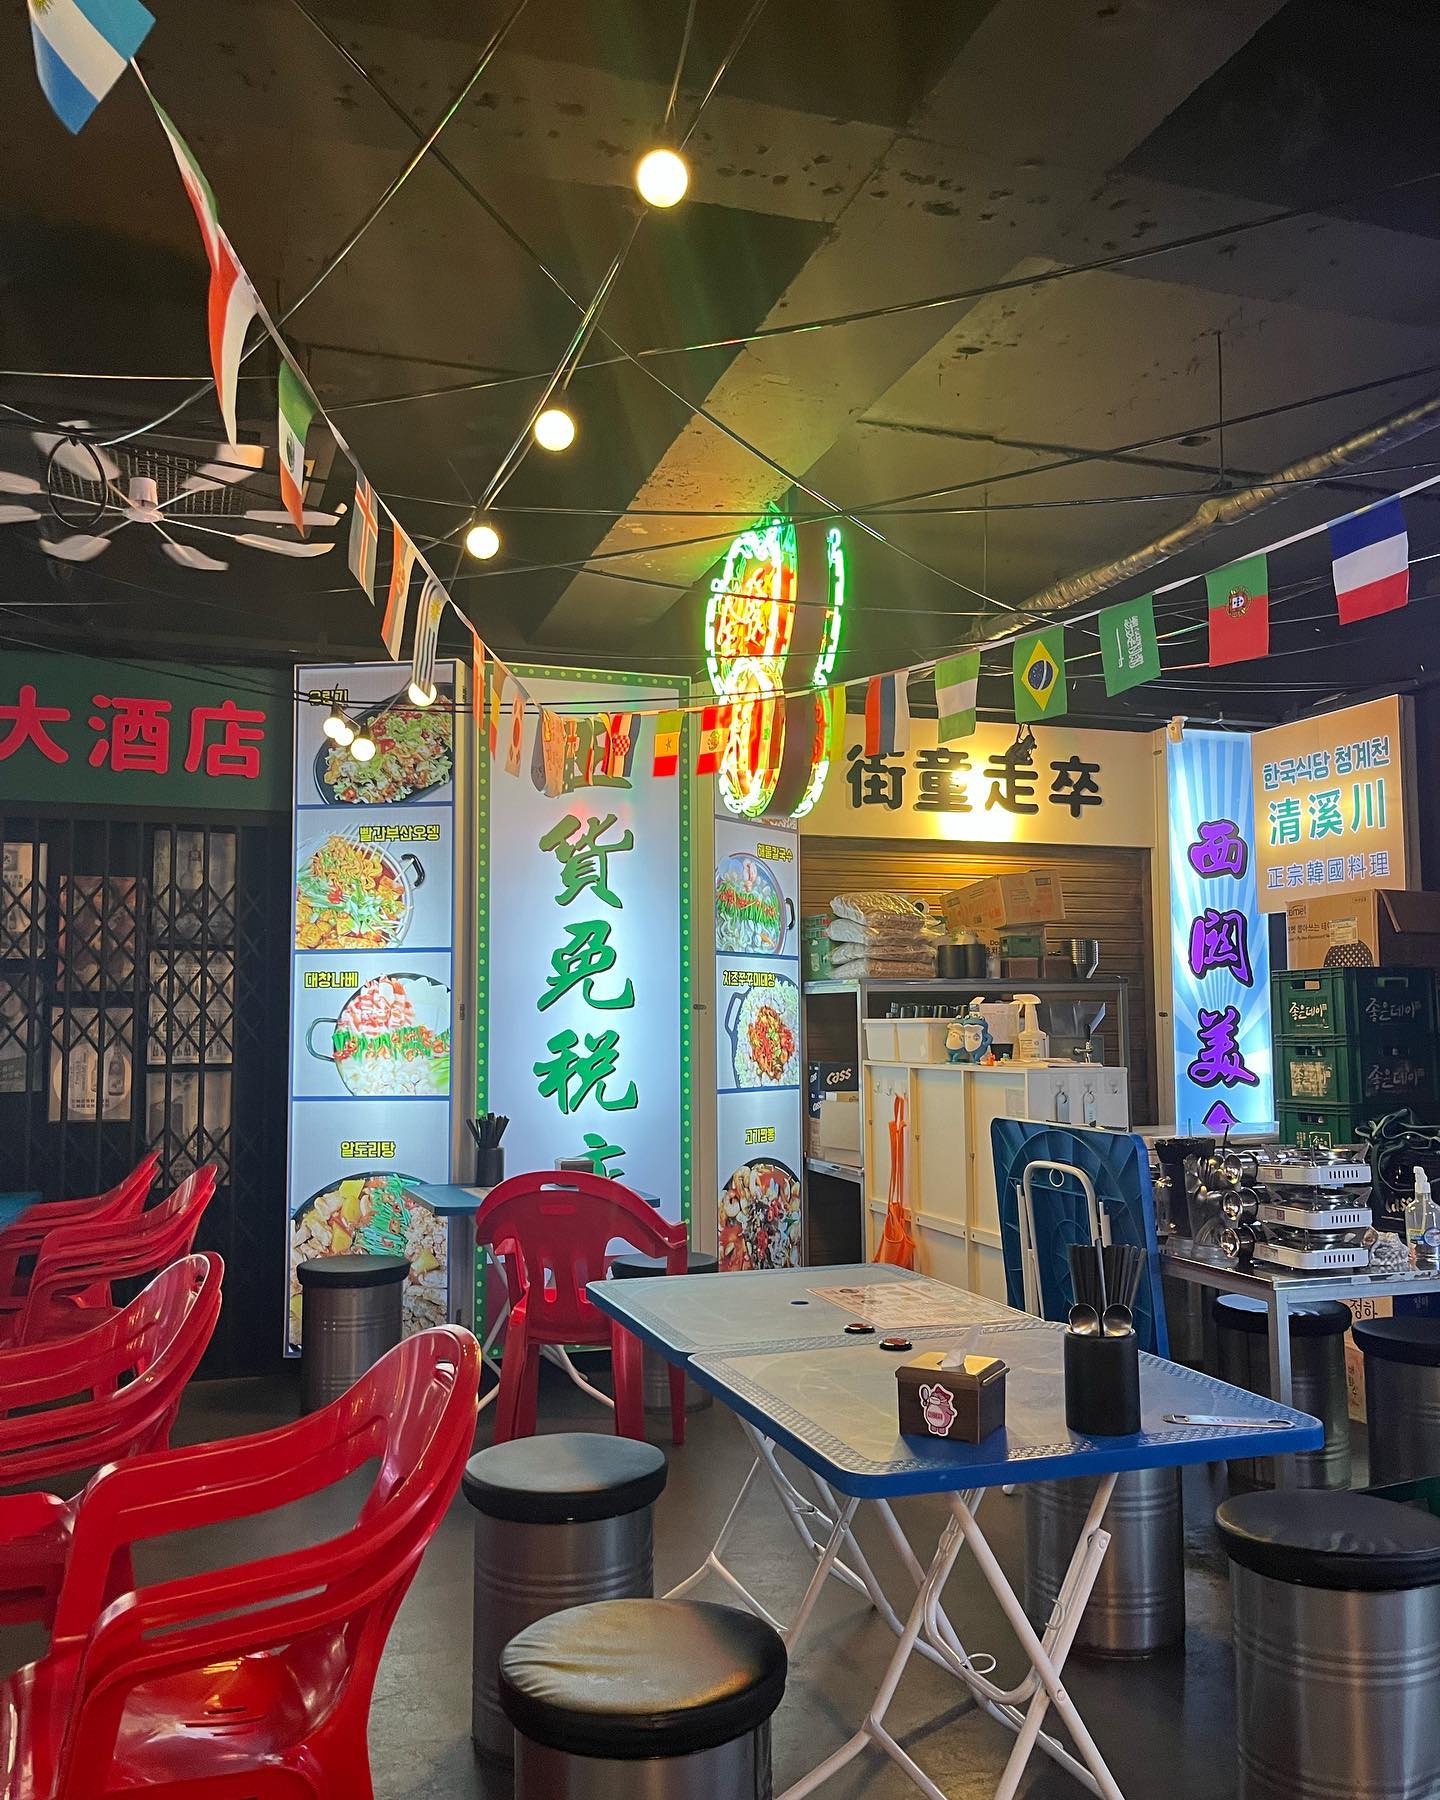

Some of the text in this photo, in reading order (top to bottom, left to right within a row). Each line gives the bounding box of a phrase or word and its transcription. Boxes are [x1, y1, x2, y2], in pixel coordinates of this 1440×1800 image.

[0, 684, 267, 779] 大酒店
[1263, 736, 1391, 791] 한국식당 청계천
[845, 743, 1103, 818] 街童走卒
[1267, 778, 1387, 847] 清溪川
[359, 824, 441, 842] 빨간부산오뎅
[1267, 851, 1390, 889] 正宗韓國料理
[304, 971, 359, 988] 대창나베
[1289, 1002, 1324, 1021] 좋은데이
[1365, 997, 1415, 1023] 좋은데이
[826, 1068, 852, 1085] Cass
[1368, 1064, 1419, 1090] 좋은데이
[341, 1141, 396, 1158] 알도리탕
